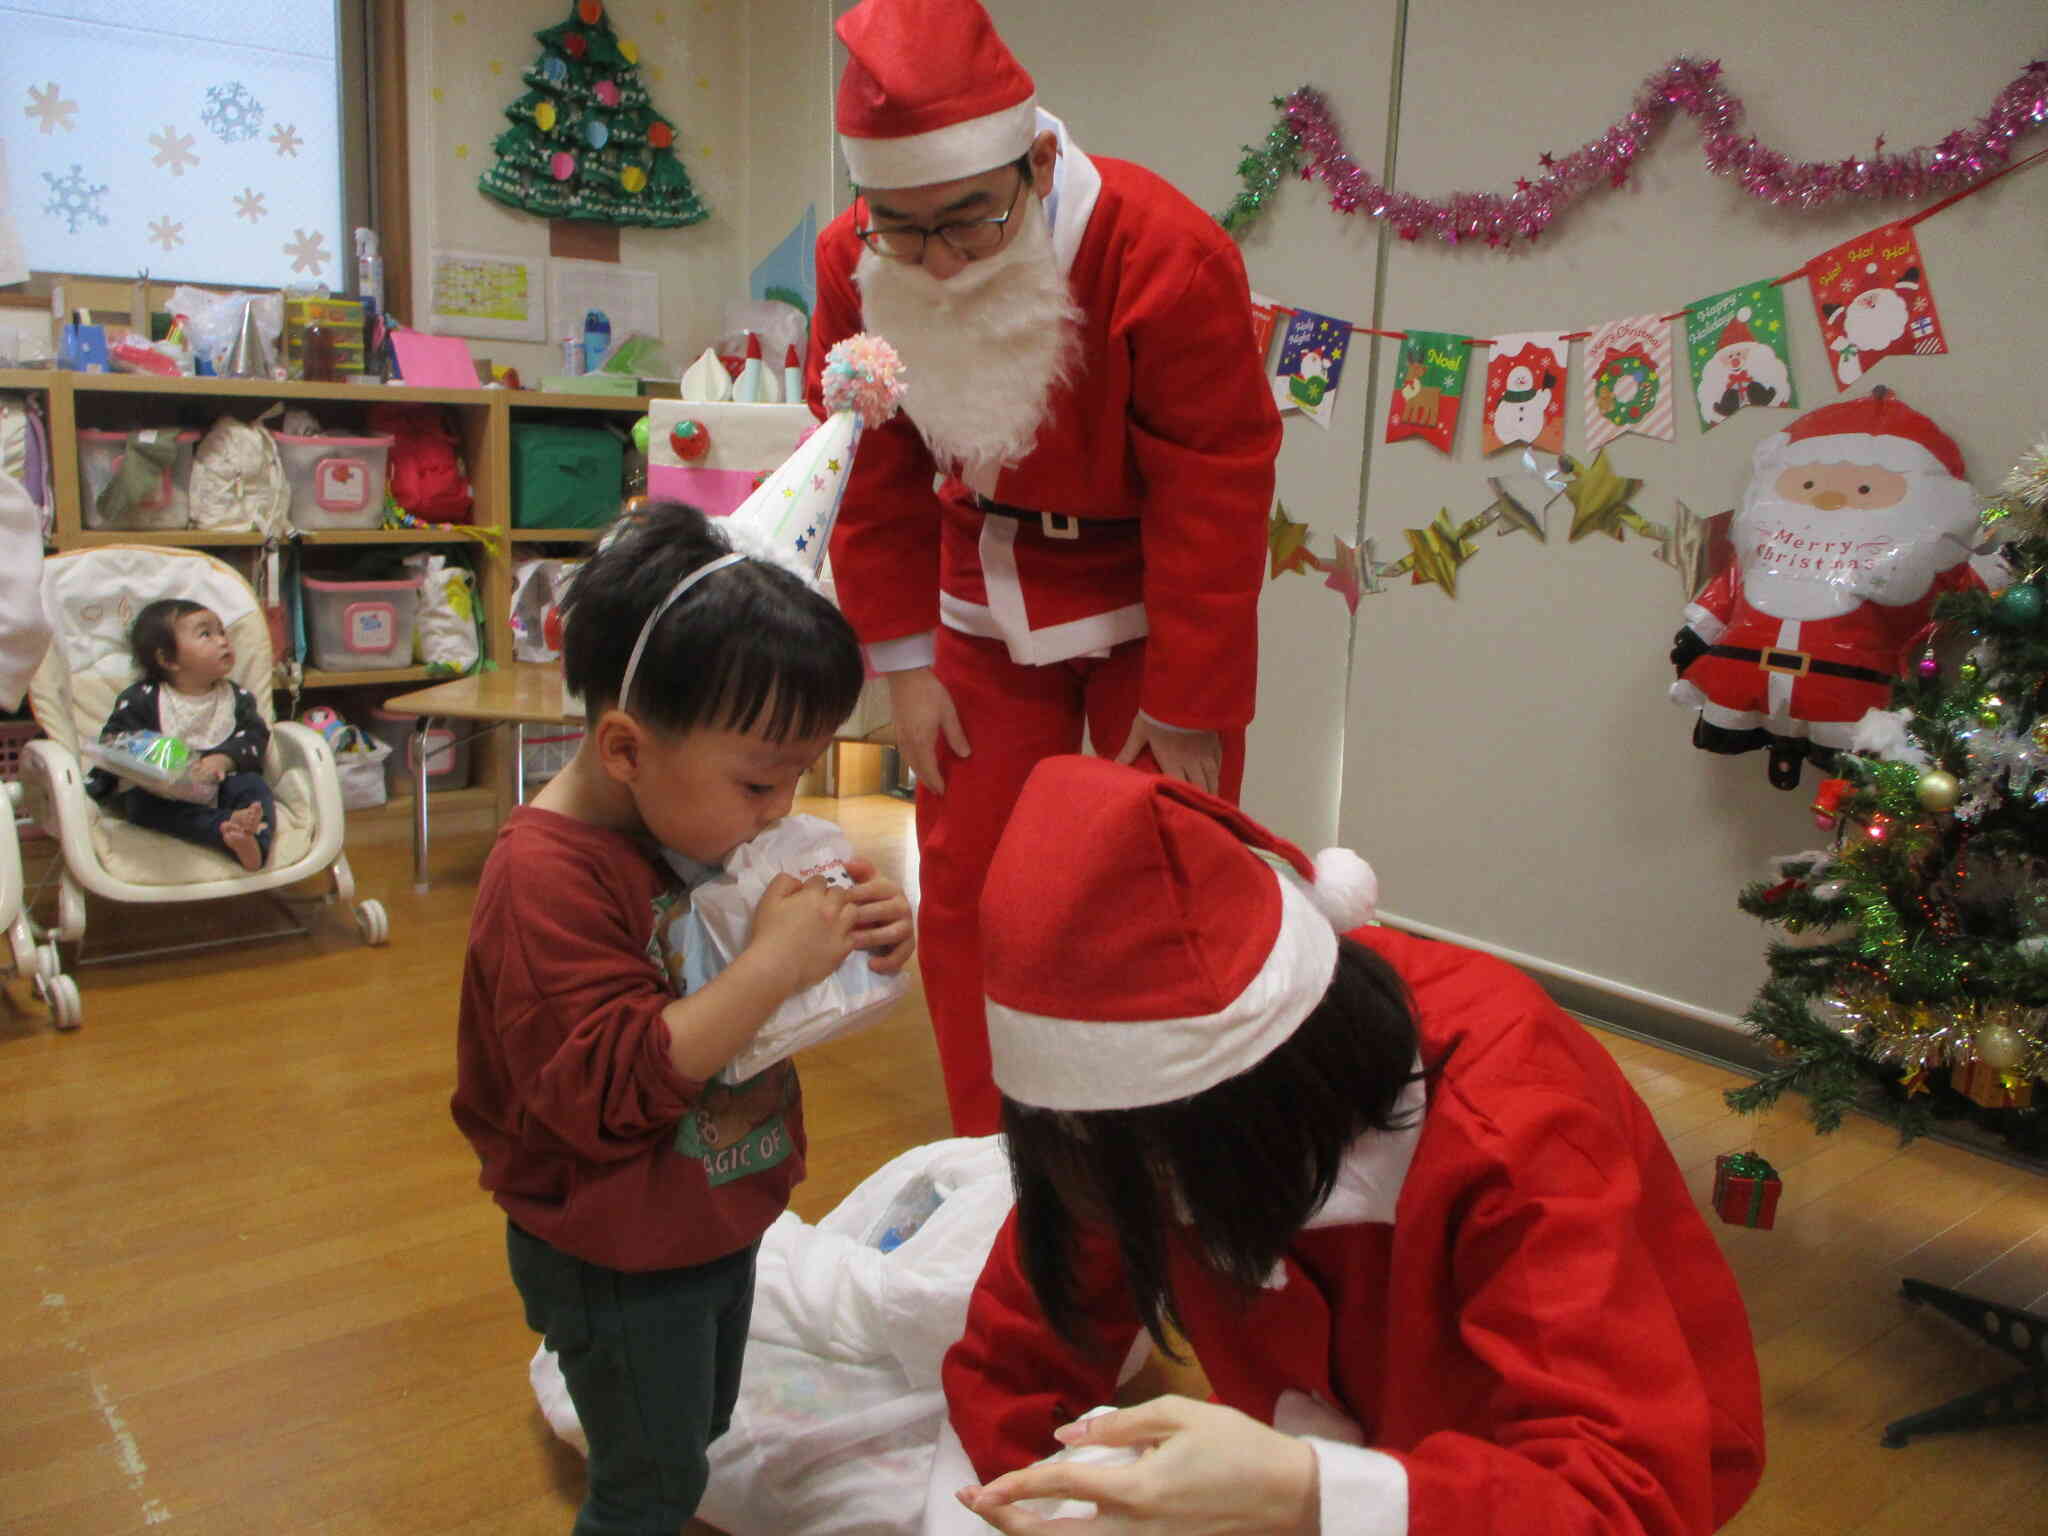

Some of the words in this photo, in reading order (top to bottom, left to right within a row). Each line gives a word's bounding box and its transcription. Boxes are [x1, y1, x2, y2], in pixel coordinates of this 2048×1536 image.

[1819, 262, 1842, 286] Ho!
[1848, 241, 1875, 262] Ho!
[1882, 240, 1911, 260] Ho!
[1696, 294, 1737, 322] Happy
[1427, 347, 1463, 371] Noel
[1774, 528, 1853, 555] Merry
[703, 1143, 752, 1177] AGIC
[760, 1127, 781, 1160] OF
